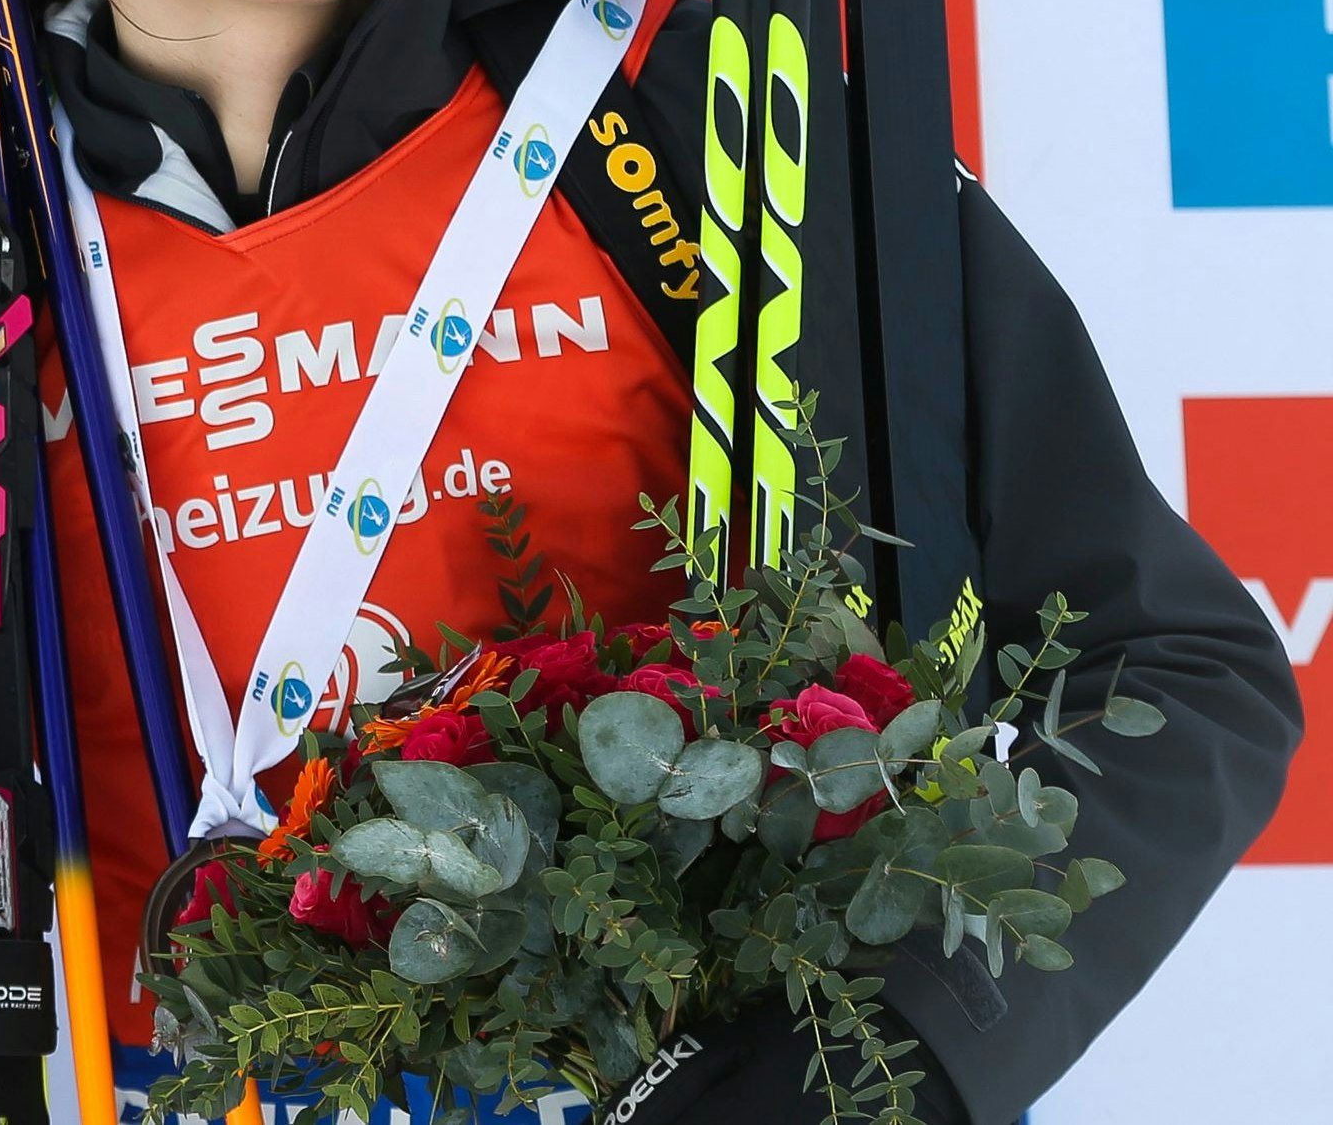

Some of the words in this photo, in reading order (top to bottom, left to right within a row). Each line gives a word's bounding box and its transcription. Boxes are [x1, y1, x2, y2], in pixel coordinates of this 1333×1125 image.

[493, 132, 512, 162] IBU
[588, 111, 700, 301] somfy
[89, 241, 102, 269] IBU
[409, 307, 428, 338] IBU
[326, 487, 346, 518] IBU
[252, 671, 269, 702] IBU
